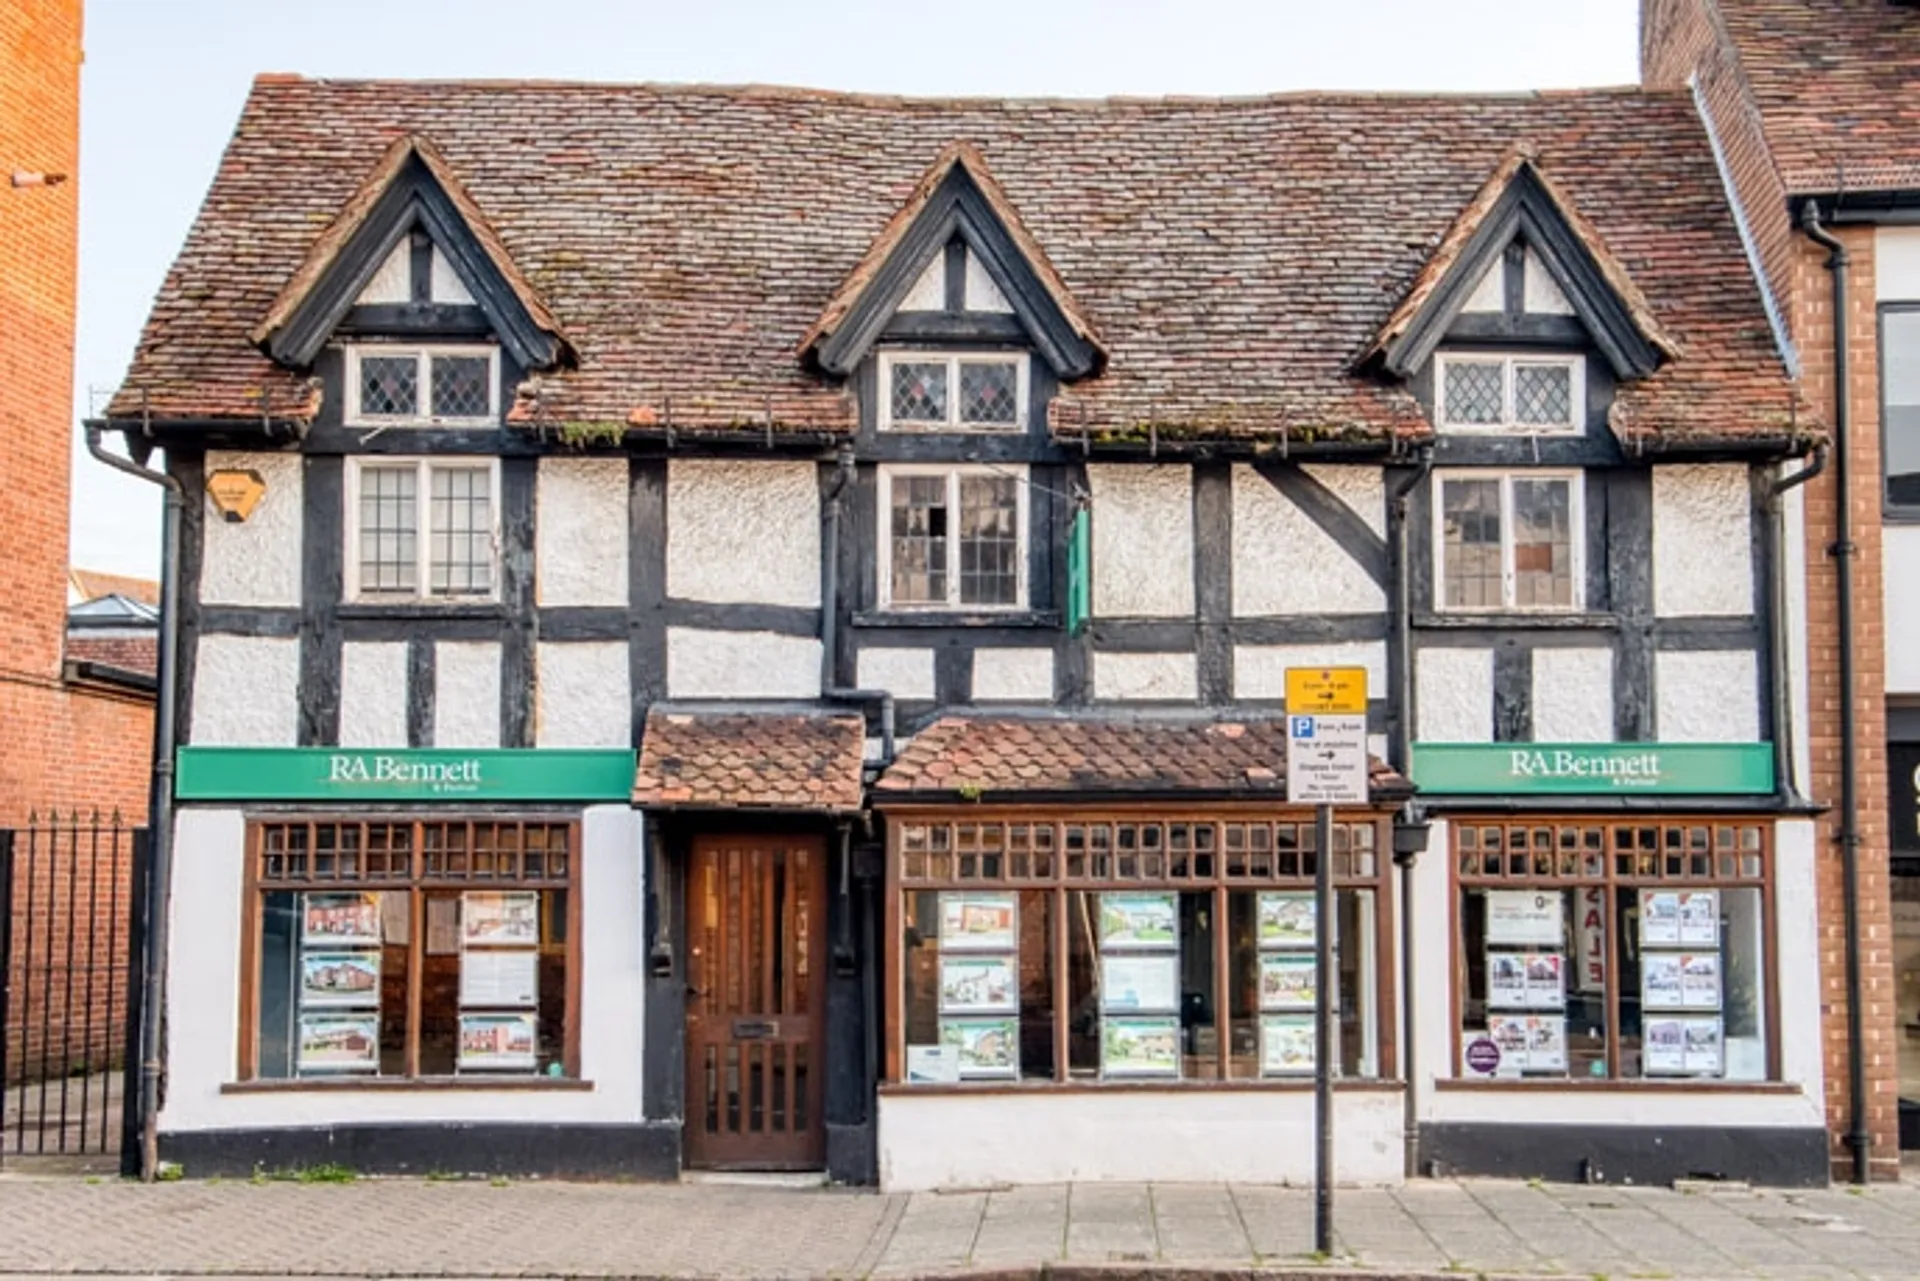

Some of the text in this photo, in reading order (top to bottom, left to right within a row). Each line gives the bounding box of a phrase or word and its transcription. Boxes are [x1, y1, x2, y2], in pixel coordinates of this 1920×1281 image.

[1297, 719, 1310, 736] P
[329, 754, 482, 782] RA Bennett
[1508, 749, 1662, 776] RA Bennett
